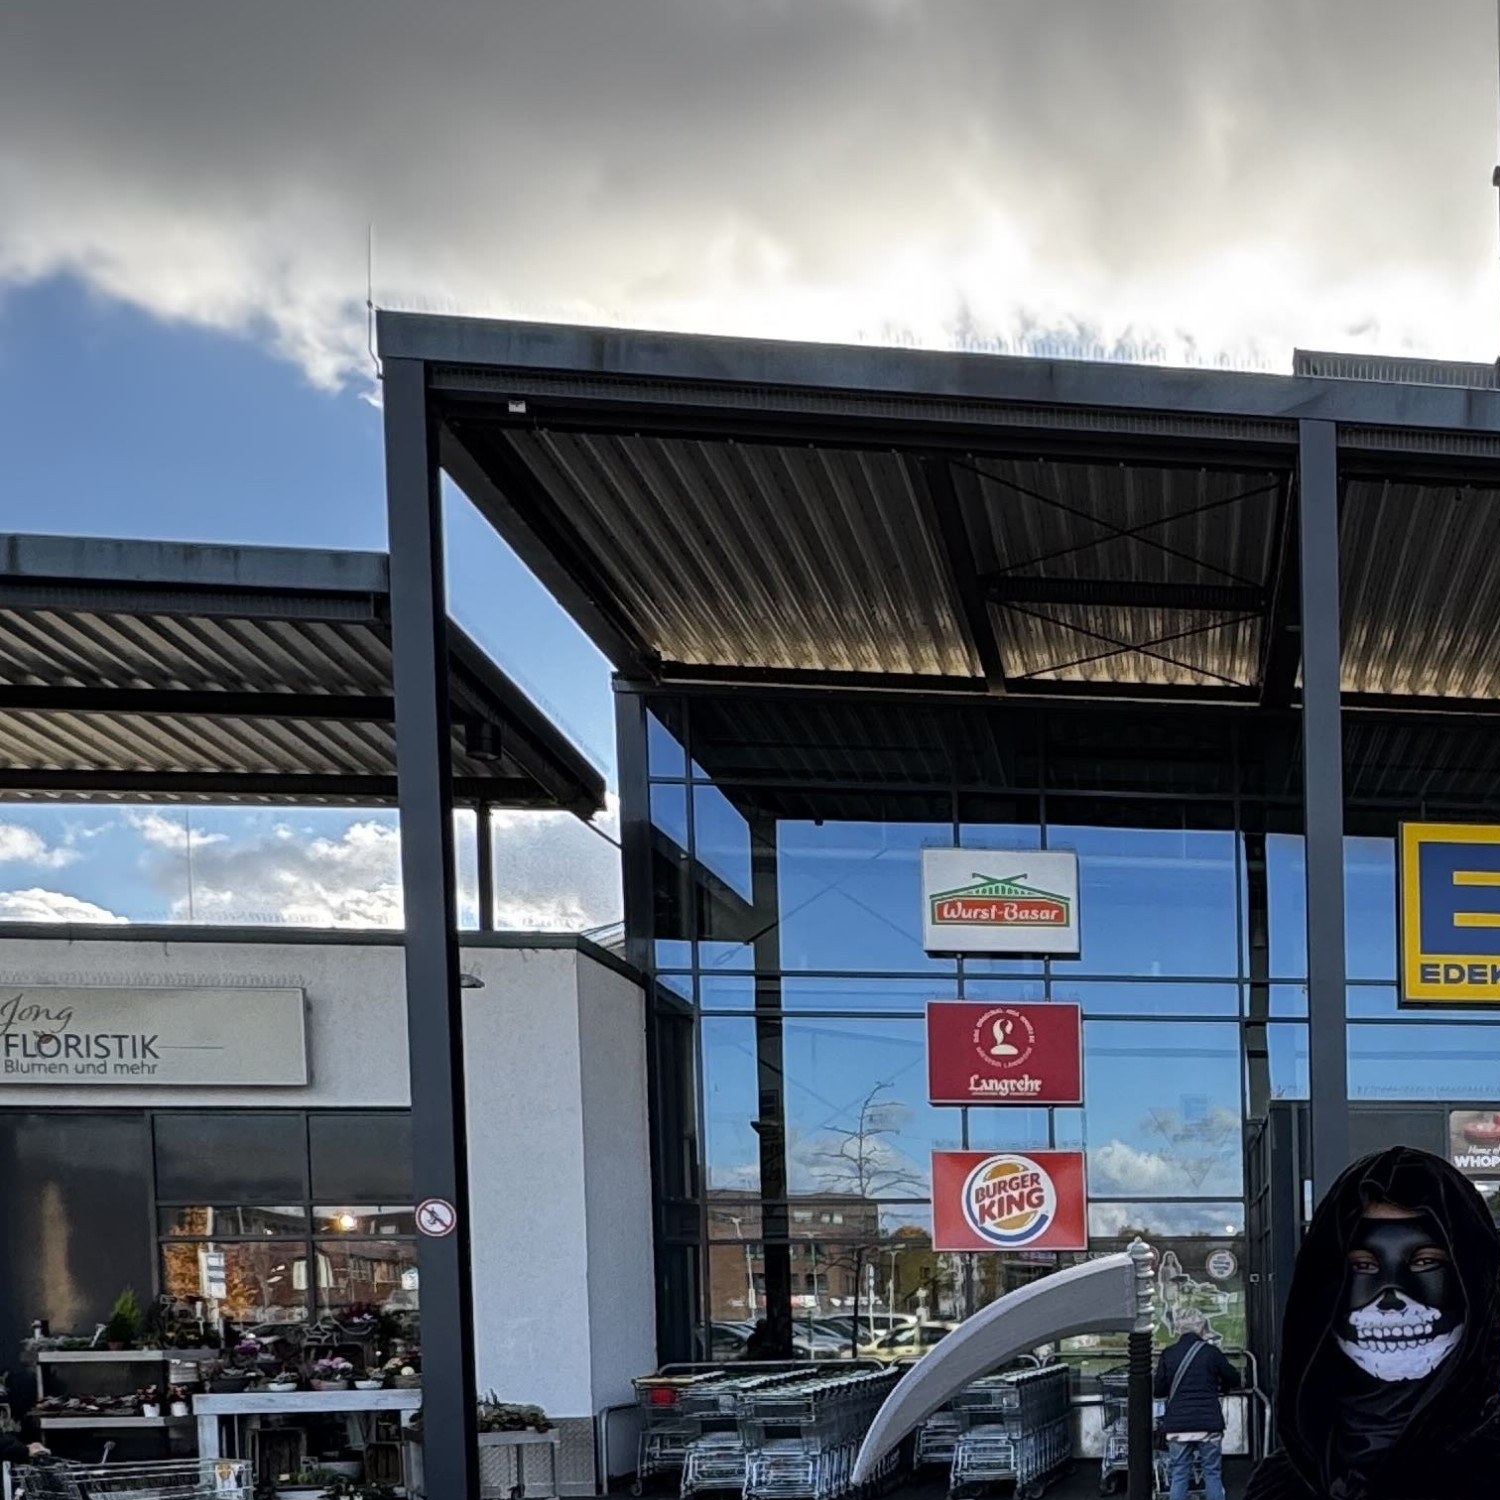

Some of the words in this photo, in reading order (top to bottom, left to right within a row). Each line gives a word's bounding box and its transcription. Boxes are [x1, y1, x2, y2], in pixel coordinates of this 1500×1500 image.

[942, 901, 1060, 921] Wurst-Basar
[0, 993, 74, 1037] Jong
[4, 1032, 160, 1060] FLORISTIK
[4, 1059, 69, 1075] Blumen
[74, 1059, 108, 1075] und
[113, 1060, 158, 1075] mehr
[974, 1172, 1041, 1204] BURGER
[978, 1187, 1045, 1225] KING
